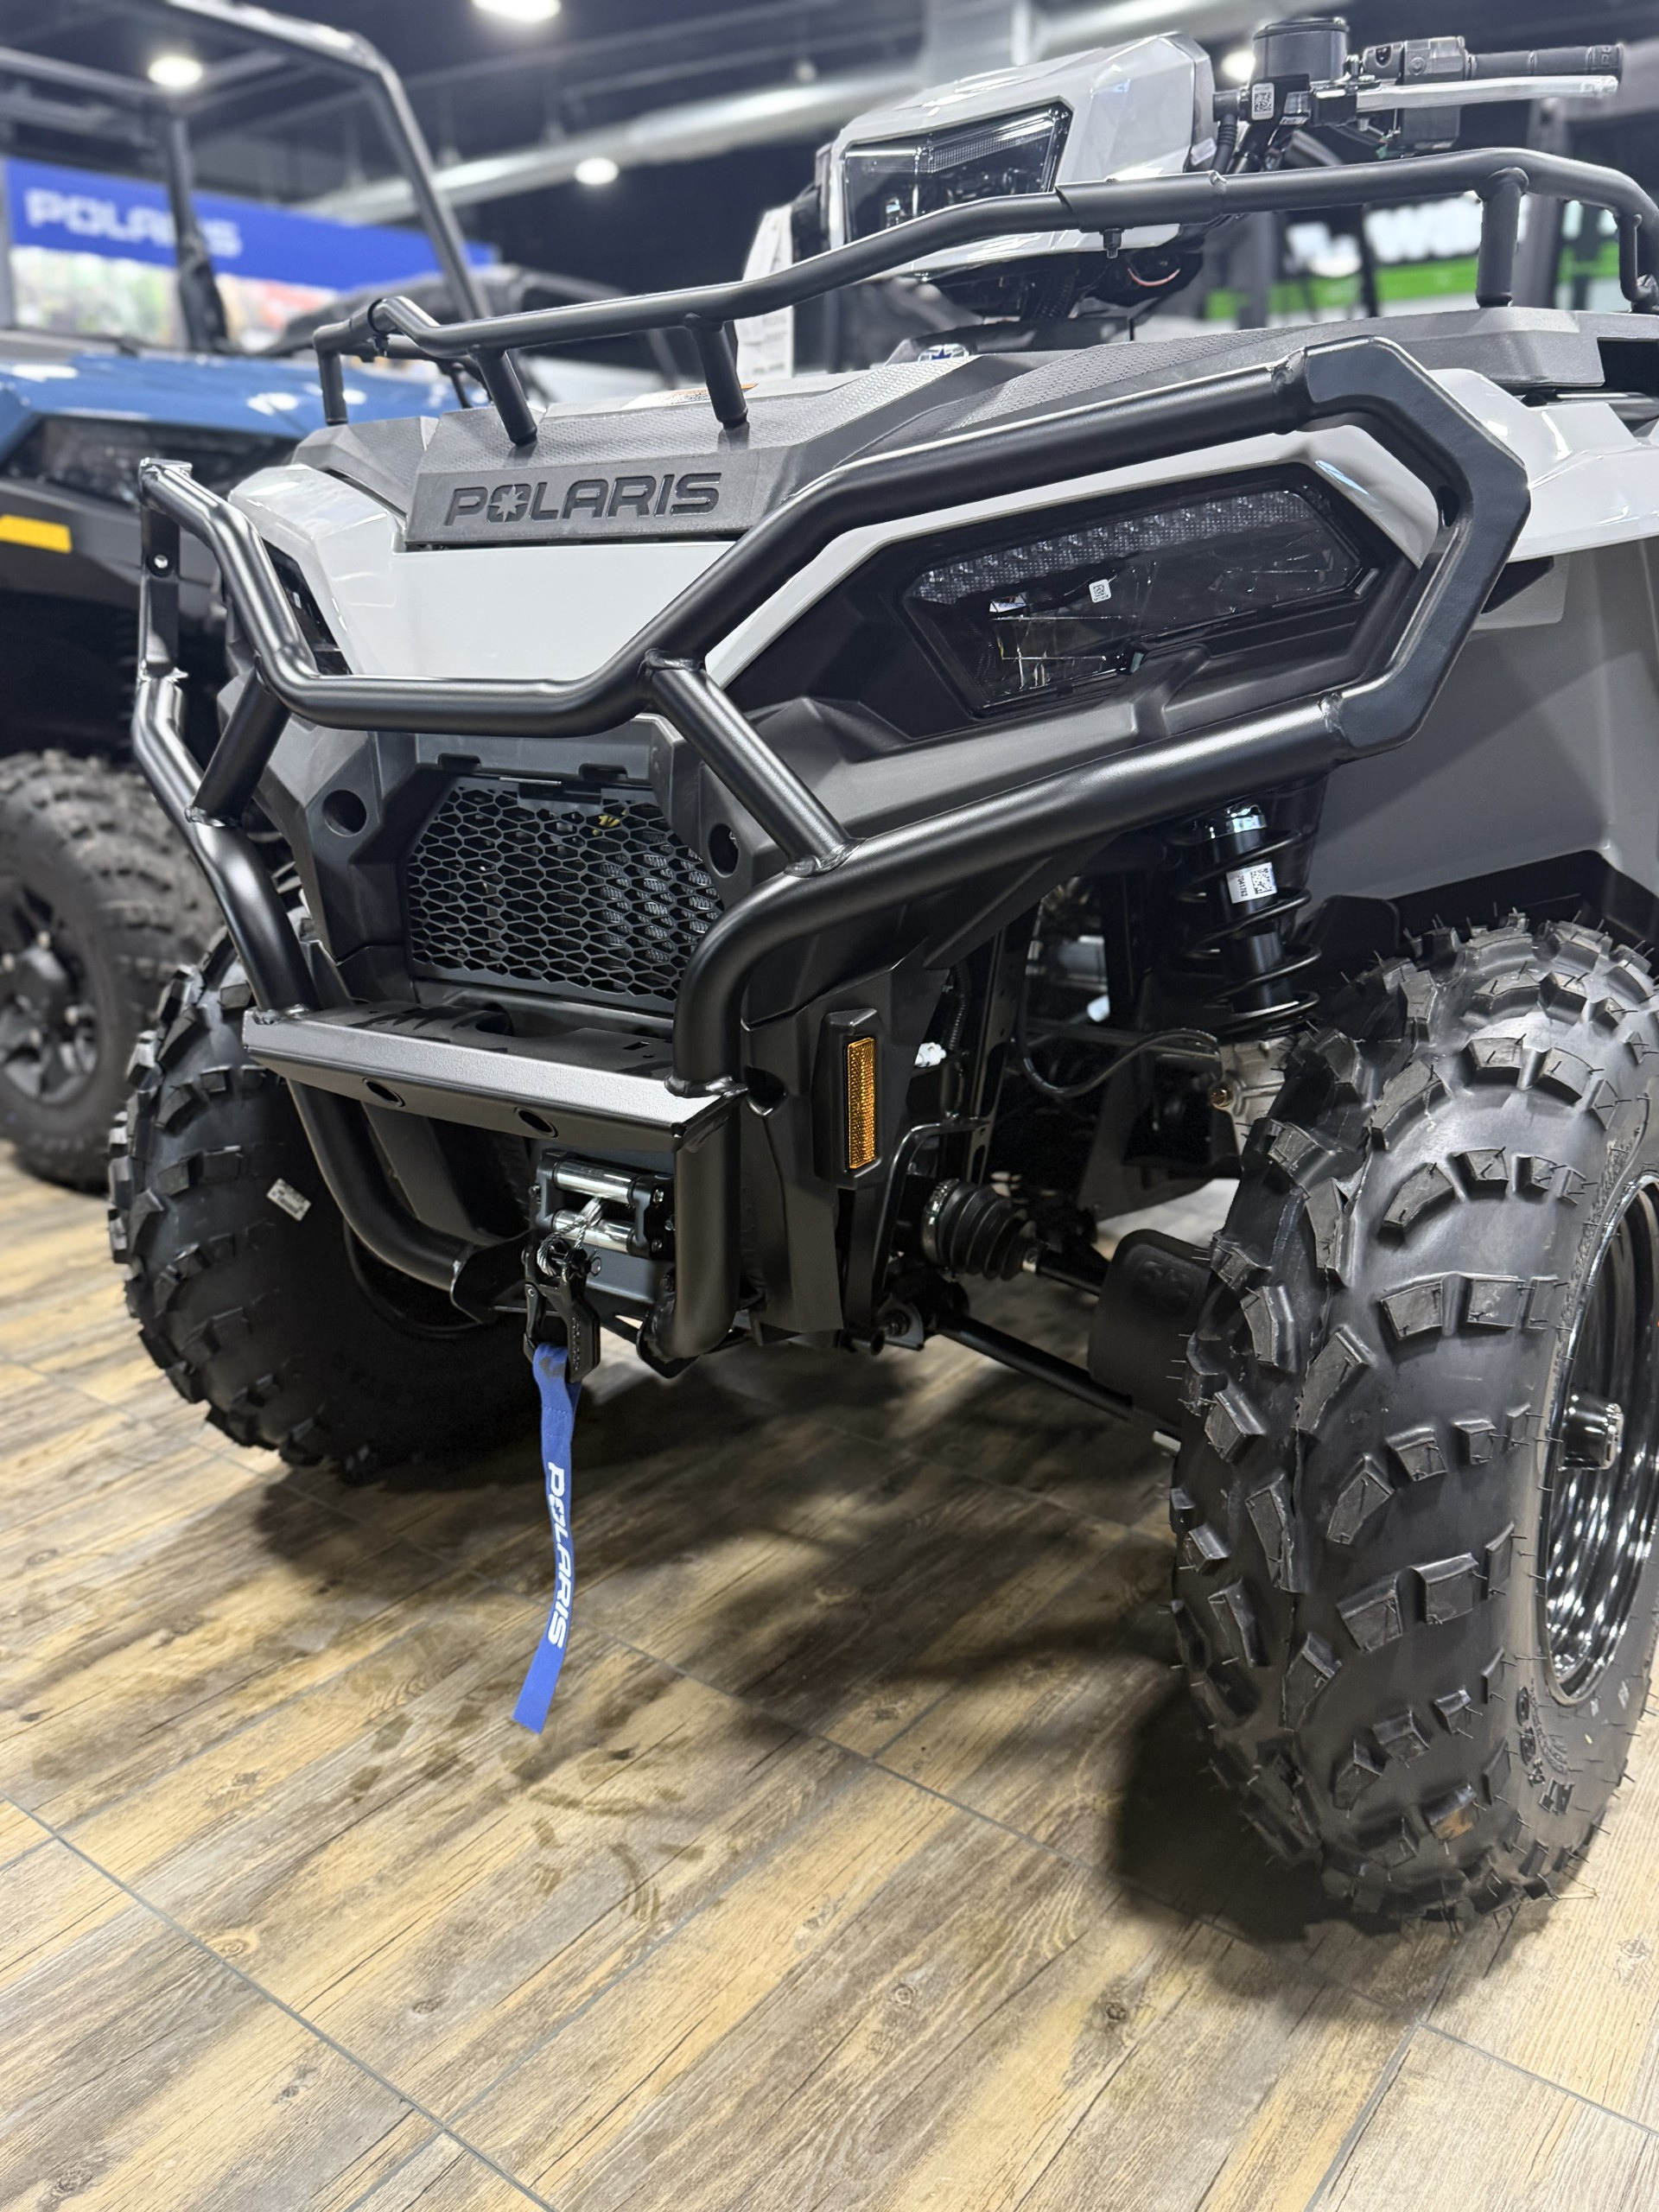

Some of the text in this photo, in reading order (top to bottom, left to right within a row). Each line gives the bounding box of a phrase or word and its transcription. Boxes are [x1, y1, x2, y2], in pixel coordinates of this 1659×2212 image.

[24, 188, 243, 258] POLAS
[443, 472, 721, 525] POLARIS
[548, 1462, 571, 1649] POLARIS
